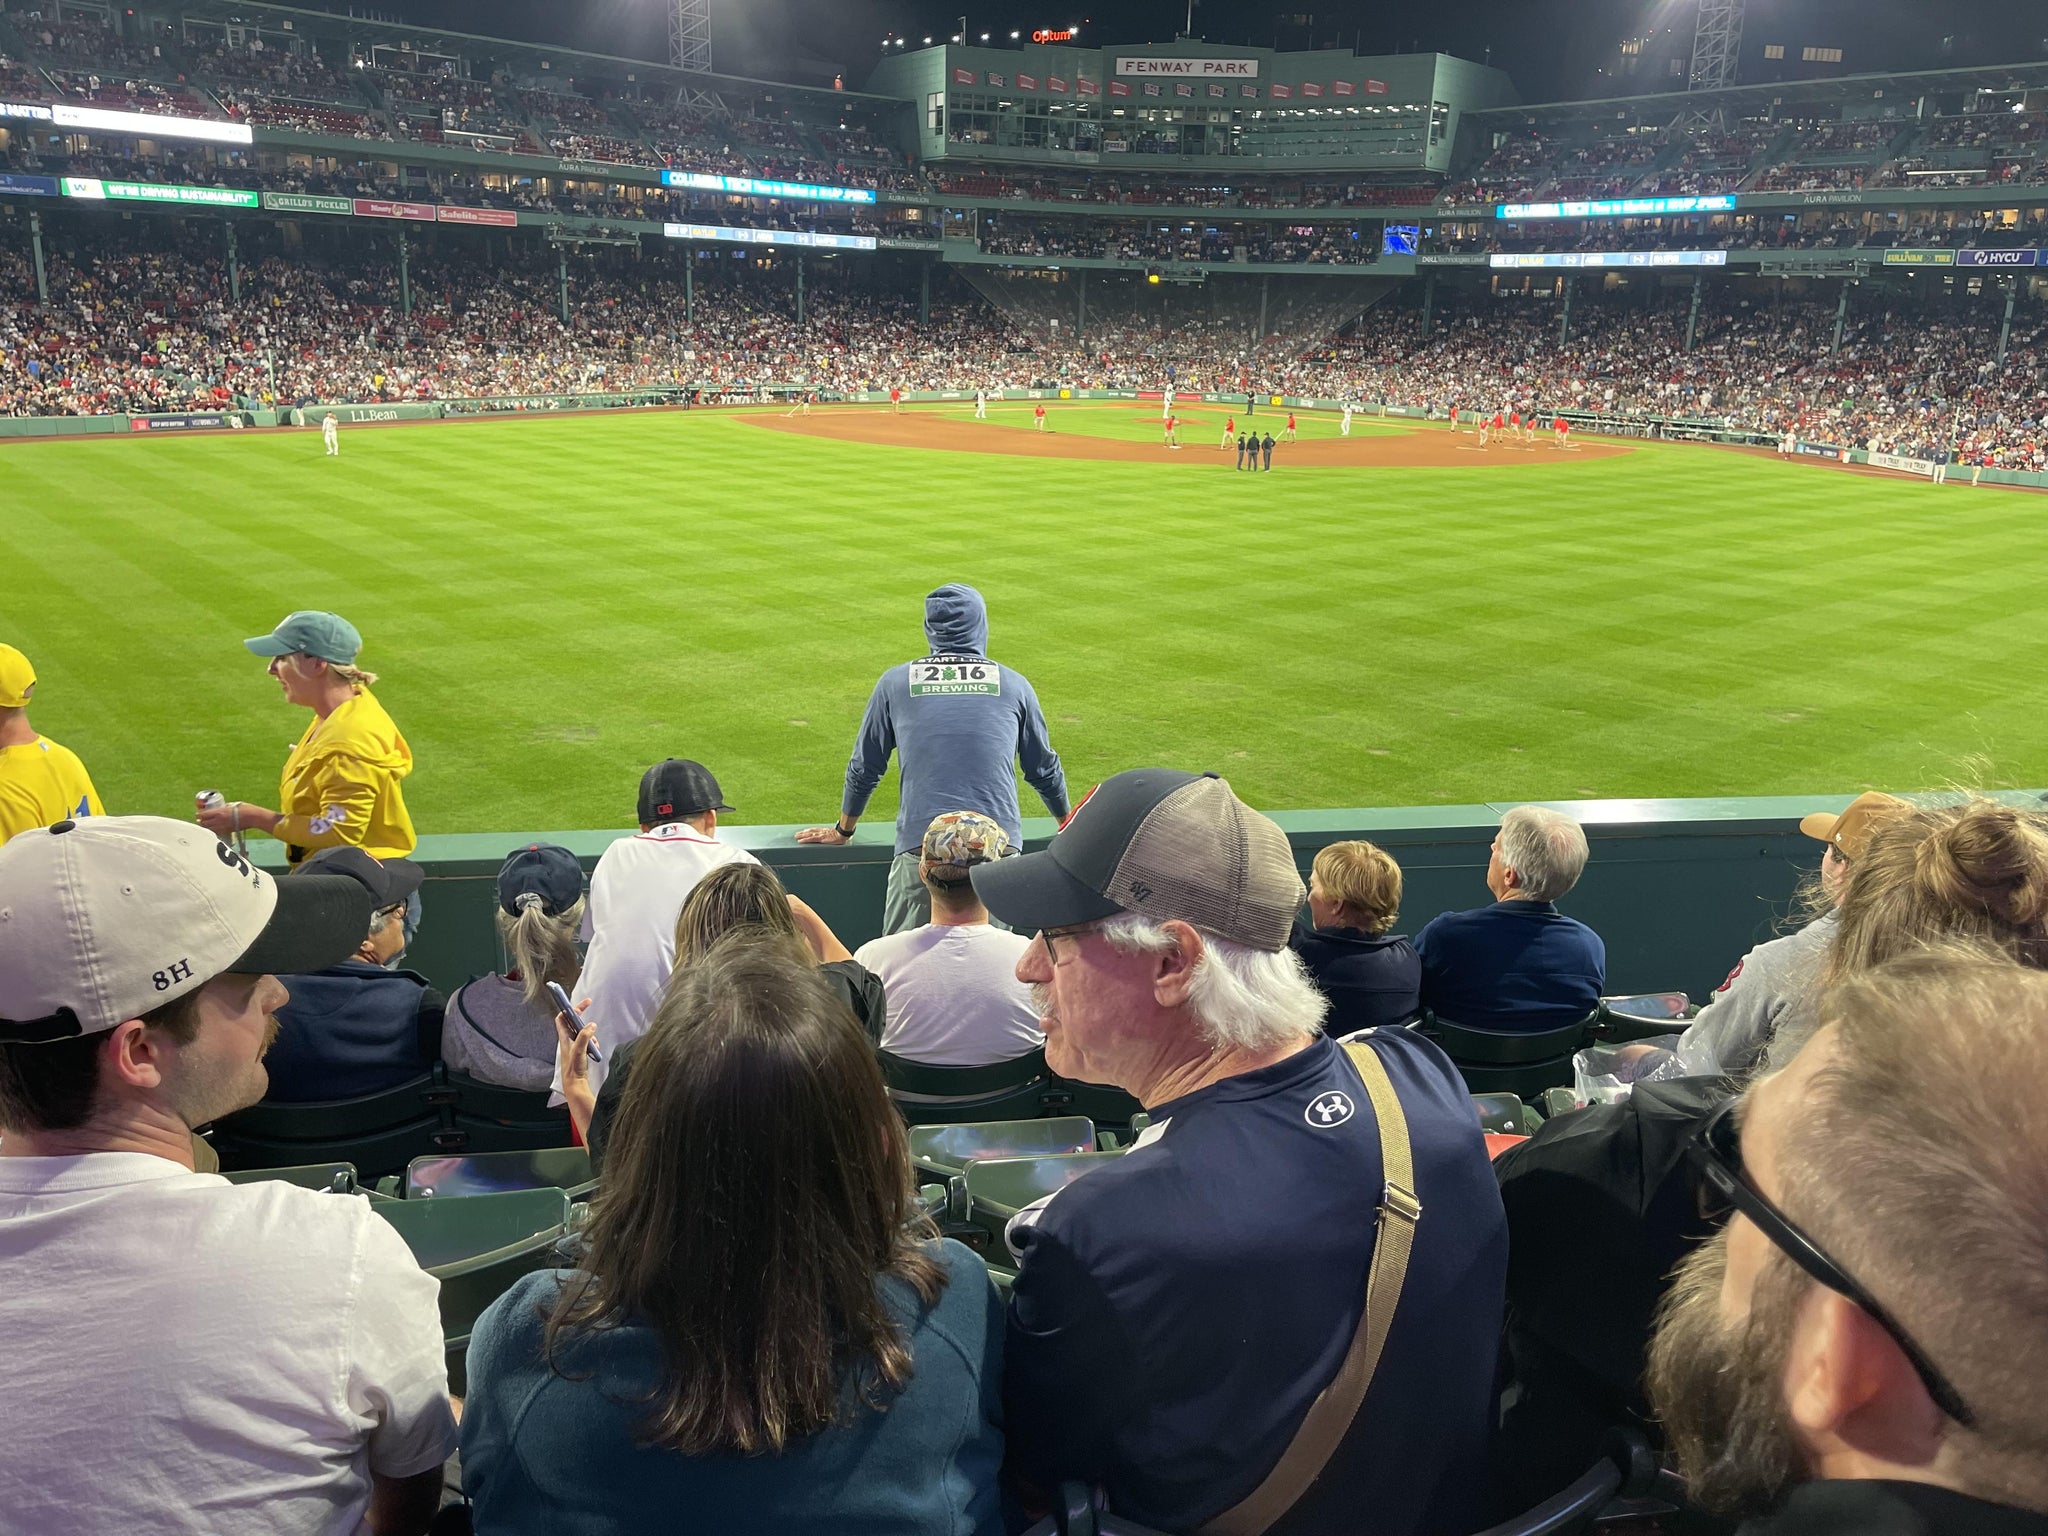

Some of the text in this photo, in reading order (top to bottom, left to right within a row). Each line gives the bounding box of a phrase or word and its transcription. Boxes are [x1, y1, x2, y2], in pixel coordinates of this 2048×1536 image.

[1032, 30, 1072, 44] Optum
[1125, 61, 1249, 74] FENWAY PARK
[141, 187, 178, 199] DRIVING
[278, 197, 349, 210] GRILLO'S PICKLES
[440, 209, 478, 221] Safelite
[1886, 253, 1951, 262] SULLIVAN TIRE
[1989, 252, 2021, 263] HYCU
[351, 409, 398, 422] L.L.Bean
[921, 684, 989, 694] BREWING
[152, 957, 194, 992] 8H
